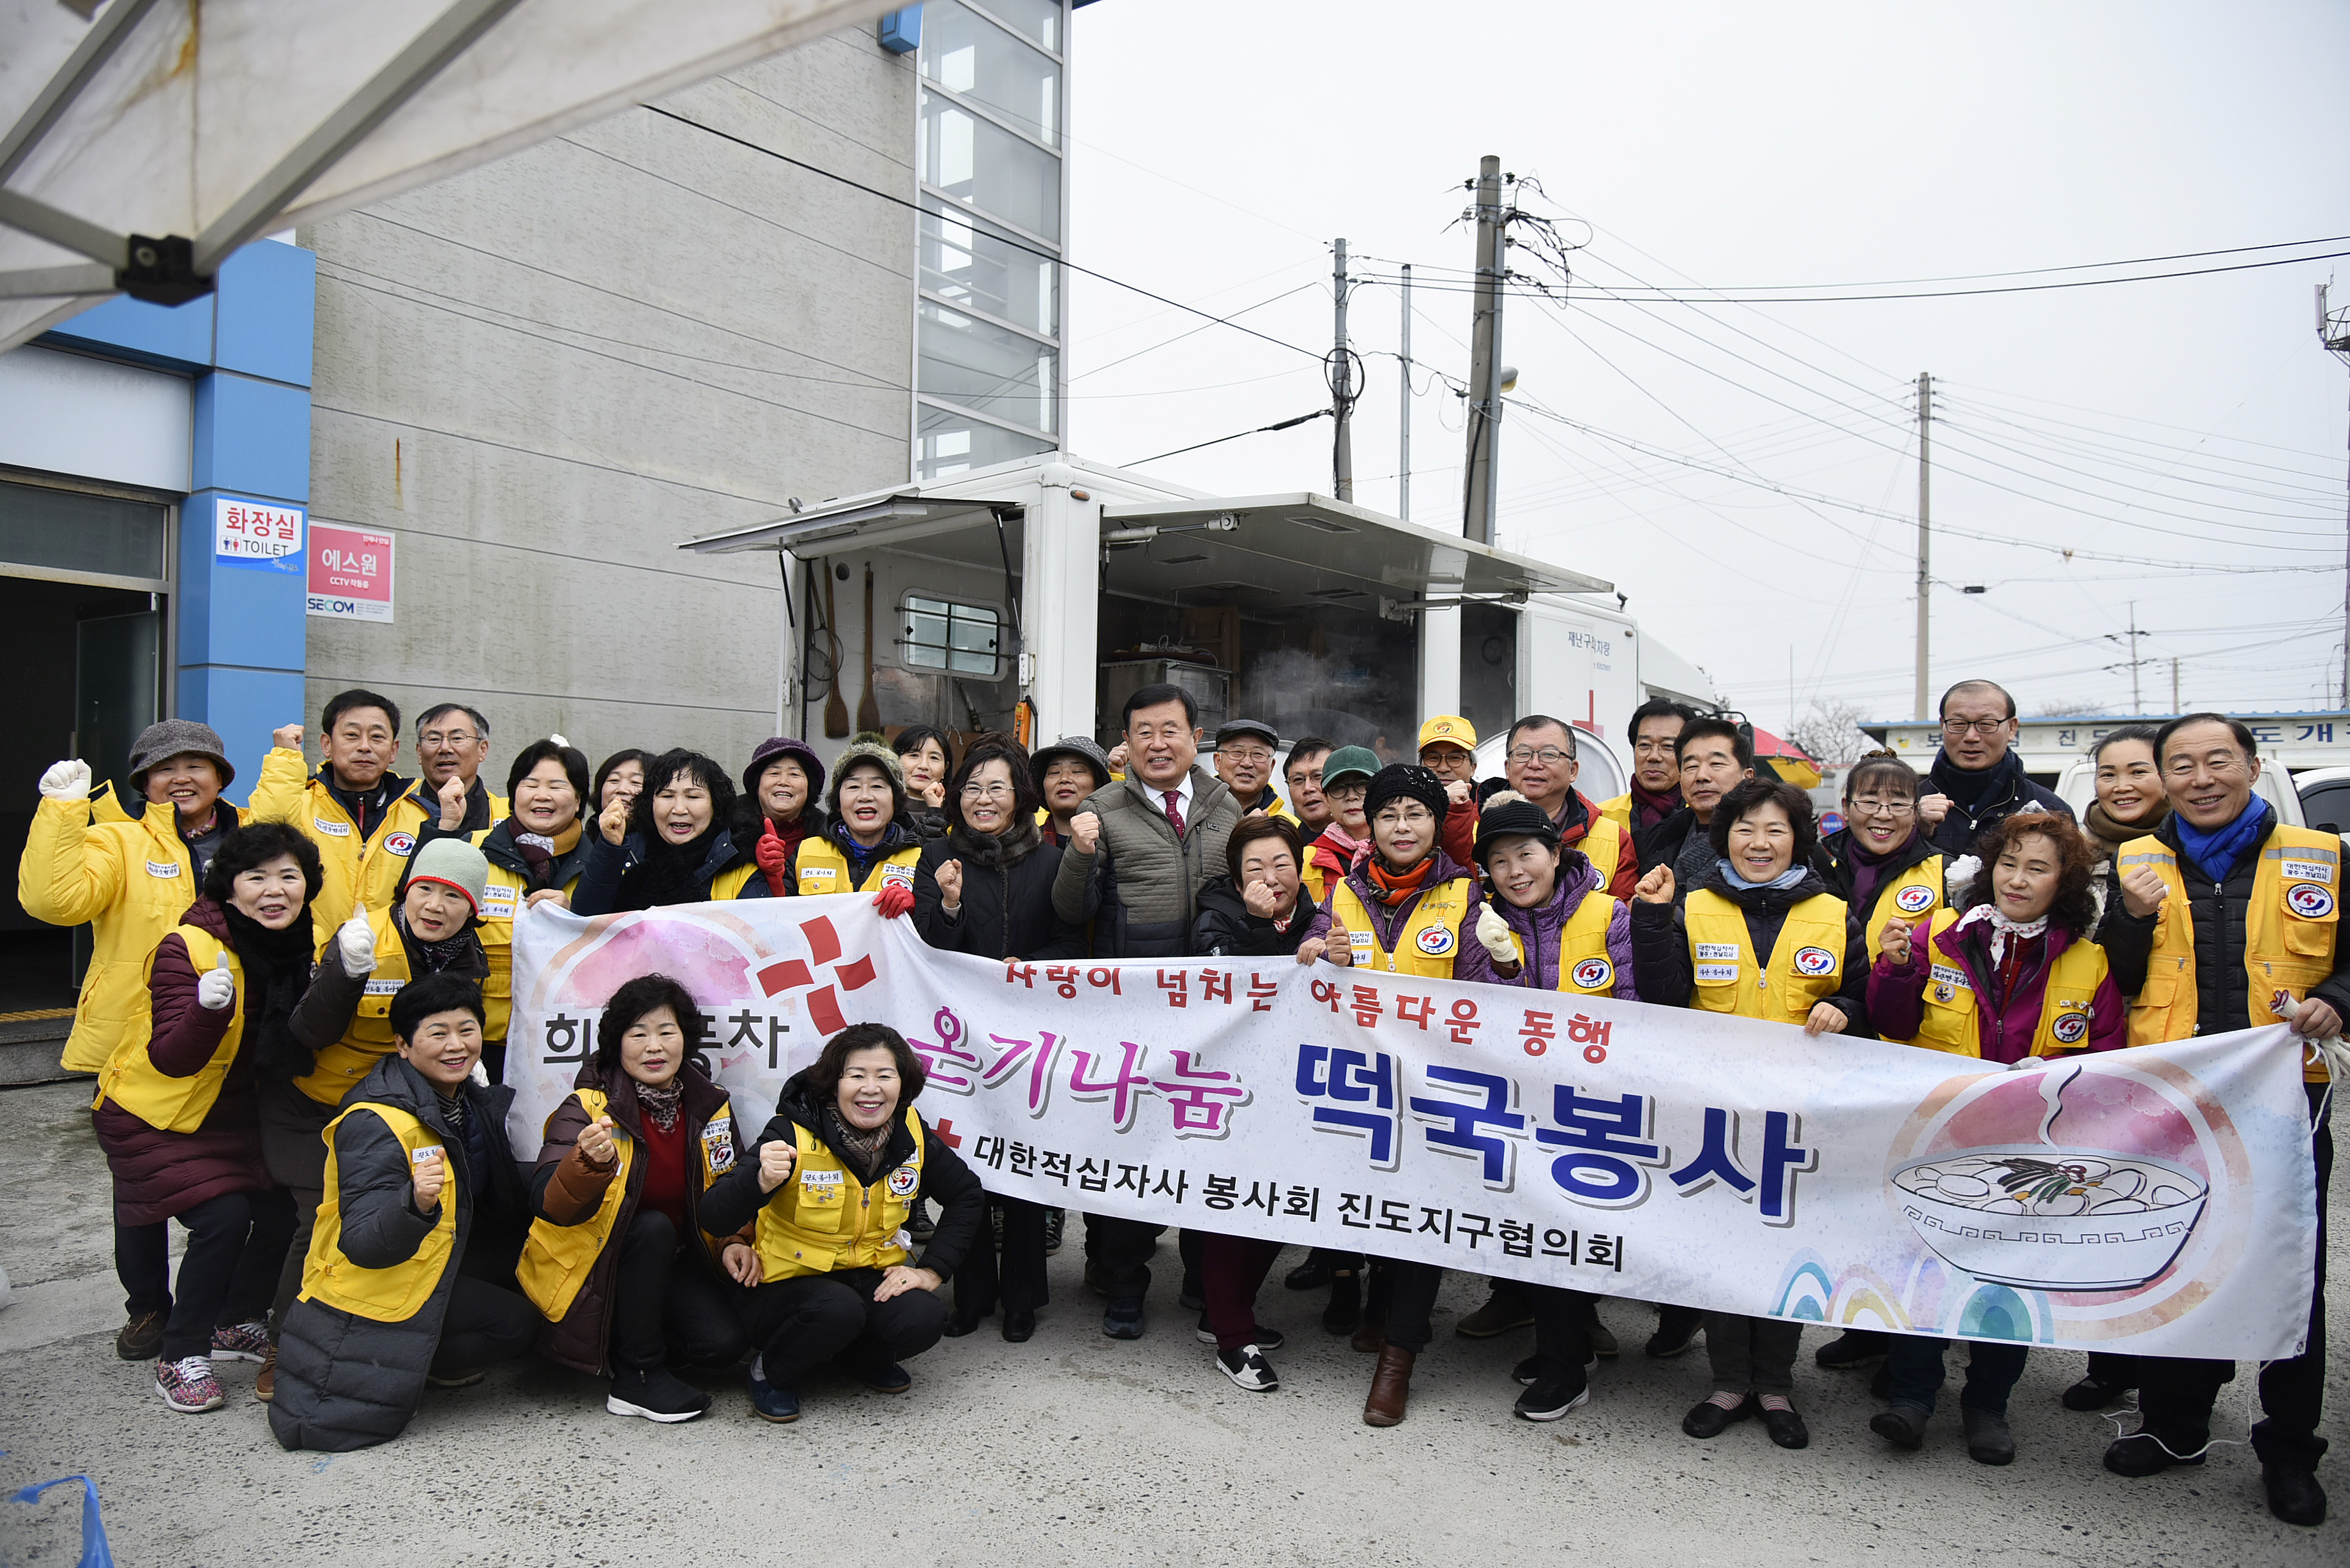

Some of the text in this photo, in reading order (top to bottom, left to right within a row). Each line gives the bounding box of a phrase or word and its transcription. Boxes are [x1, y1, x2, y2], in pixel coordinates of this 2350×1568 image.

[226, 507, 294, 541] 화장실
[243, 539, 289, 557] TOILET
[321, 548, 377, 577] 에스원
[330, 577, 369, 589] CCTV 작동중
[308, 598, 354, 614] SECOM
[1206, 822, 1220, 832] K2
[2287, 863, 2328, 873] 대한적십자사
[2291, 886, 2307, 894] KOREAN
[1006, 963, 1612, 1064] 사랑이 넘치는 아름다운 동행
[543, 1009, 790, 1069] 희차
[907, 1006, 1806, 1217] 온기나눔 떡국봉사
[974, 1135, 1624, 1272] 대한적십자사 봉사회 진도지구협의회
